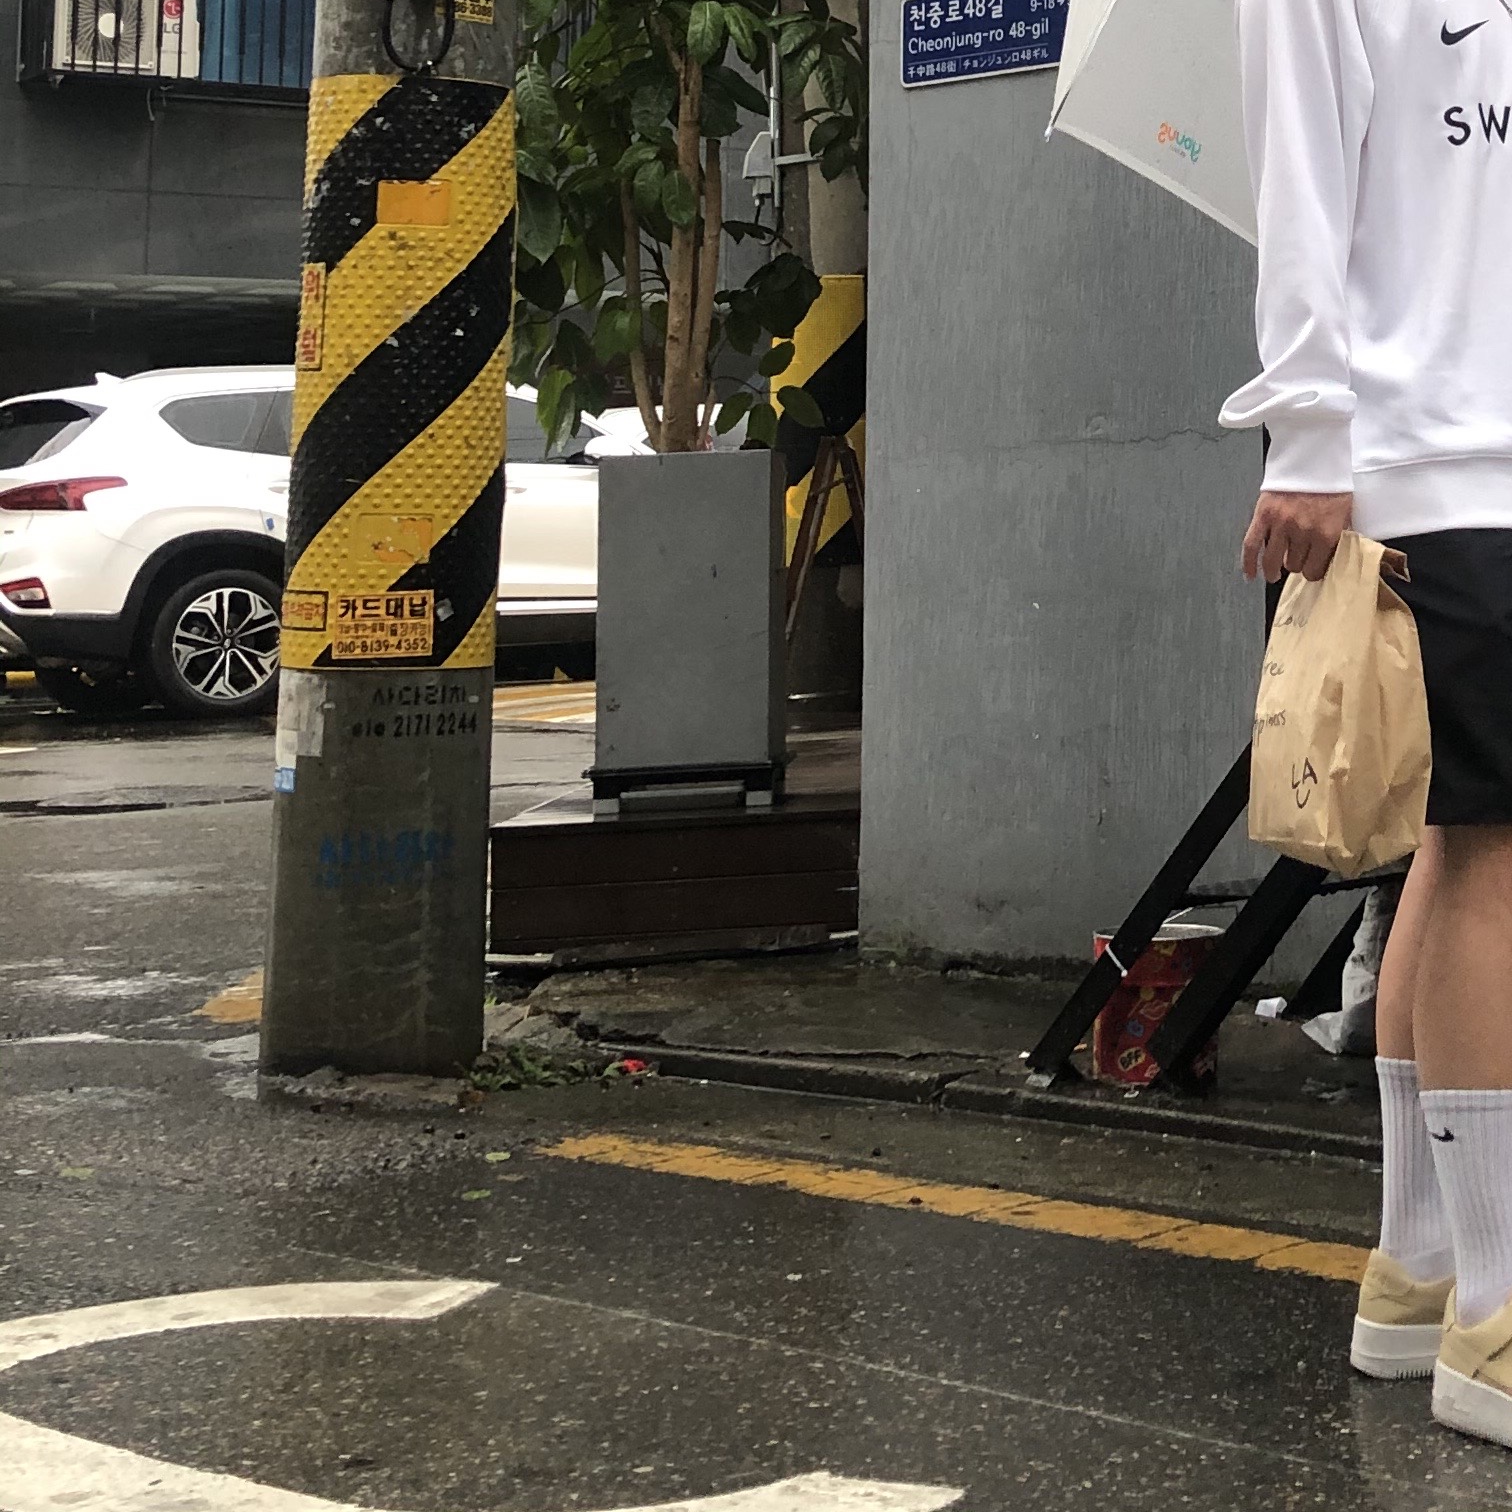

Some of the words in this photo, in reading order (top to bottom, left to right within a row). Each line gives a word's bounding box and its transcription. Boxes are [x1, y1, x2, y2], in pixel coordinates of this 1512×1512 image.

[908, 29, 1004, 55] Cheonjung-ro
[1009, 17, 1049, 40] 48-gil
[339, 596, 427, 619] 카드대납
